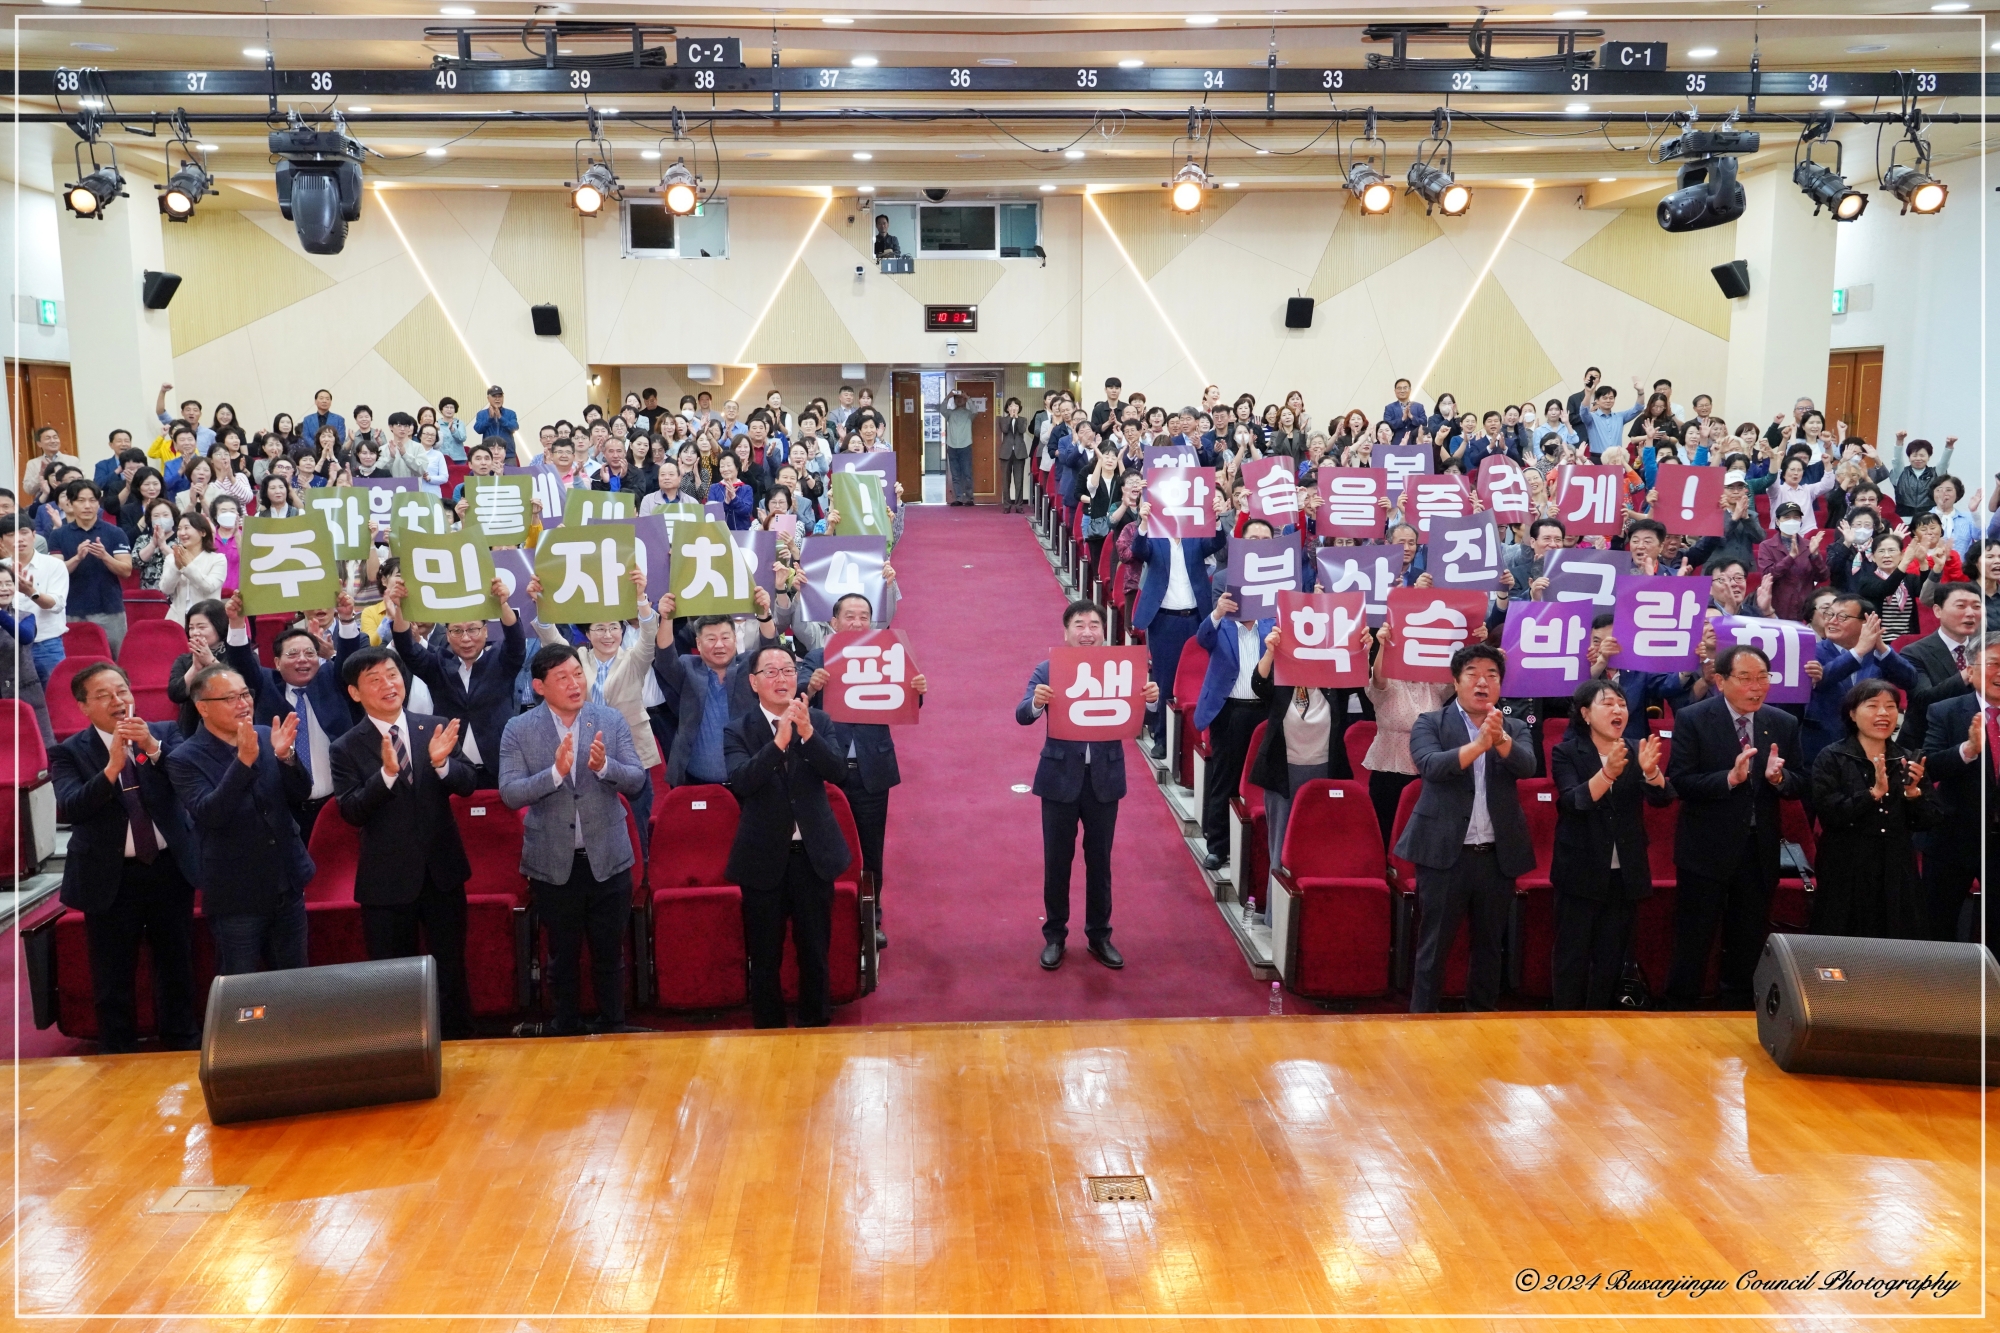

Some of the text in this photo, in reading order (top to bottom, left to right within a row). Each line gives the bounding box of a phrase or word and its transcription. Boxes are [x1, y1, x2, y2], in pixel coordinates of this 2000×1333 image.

[689, 44, 723, 63] C-2
[1621, 47, 1650, 65] C-1
[57, 70, 80, 90] 38
[187, 72, 207, 91] 37
[311, 72, 332, 90] 36
[436, 70, 456, 90] 40
[570, 70, 590, 89] 39
[695, 71, 714, 89] 38
[819, 70, 839, 88] 37
[950, 69, 970, 88] 36
[1077, 69, 1097, 88] 35
[1204, 70, 1224, 88] 34
[1323, 70, 1342, 89] 33
[1452, 72, 1471, 90] 32
[1571, 74, 1588, 91] 31
[1686, 74, 1706, 92] 35
[1808, 74, 1827, 92] 34
[1917, 75, 1936, 92] 33
[474, 485, 525, 535] 를
[859, 483, 875, 526] !
[1159, 476, 1209, 525] 학
[1257, 465, 1298, 515] 습
[1329, 477, 1377, 526] 을
[1489, 465, 1528, 512] 겁
[1568, 474, 1616, 523] 게
[1681, 475, 1699, 520] !
[312, 496, 364, 547] 자
[250, 529, 325, 598] 주
[551, 538, 626, 606] 자
[825, 551, 864, 594] 4
[1442, 523, 1498, 582] 진
[412, 543, 486, 609] 민
[1240, 547, 1296, 606] 부
[1332, 557, 1394, 614] 산
[1290, 606, 1355, 673] 학
[1402, 600, 1468, 667] 습
[1633, 590, 1700, 656] 람
[1520, 615, 1586, 681] 박
[841, 643, 905, 710] 평
[1065, 660, 1132, 726] 생
